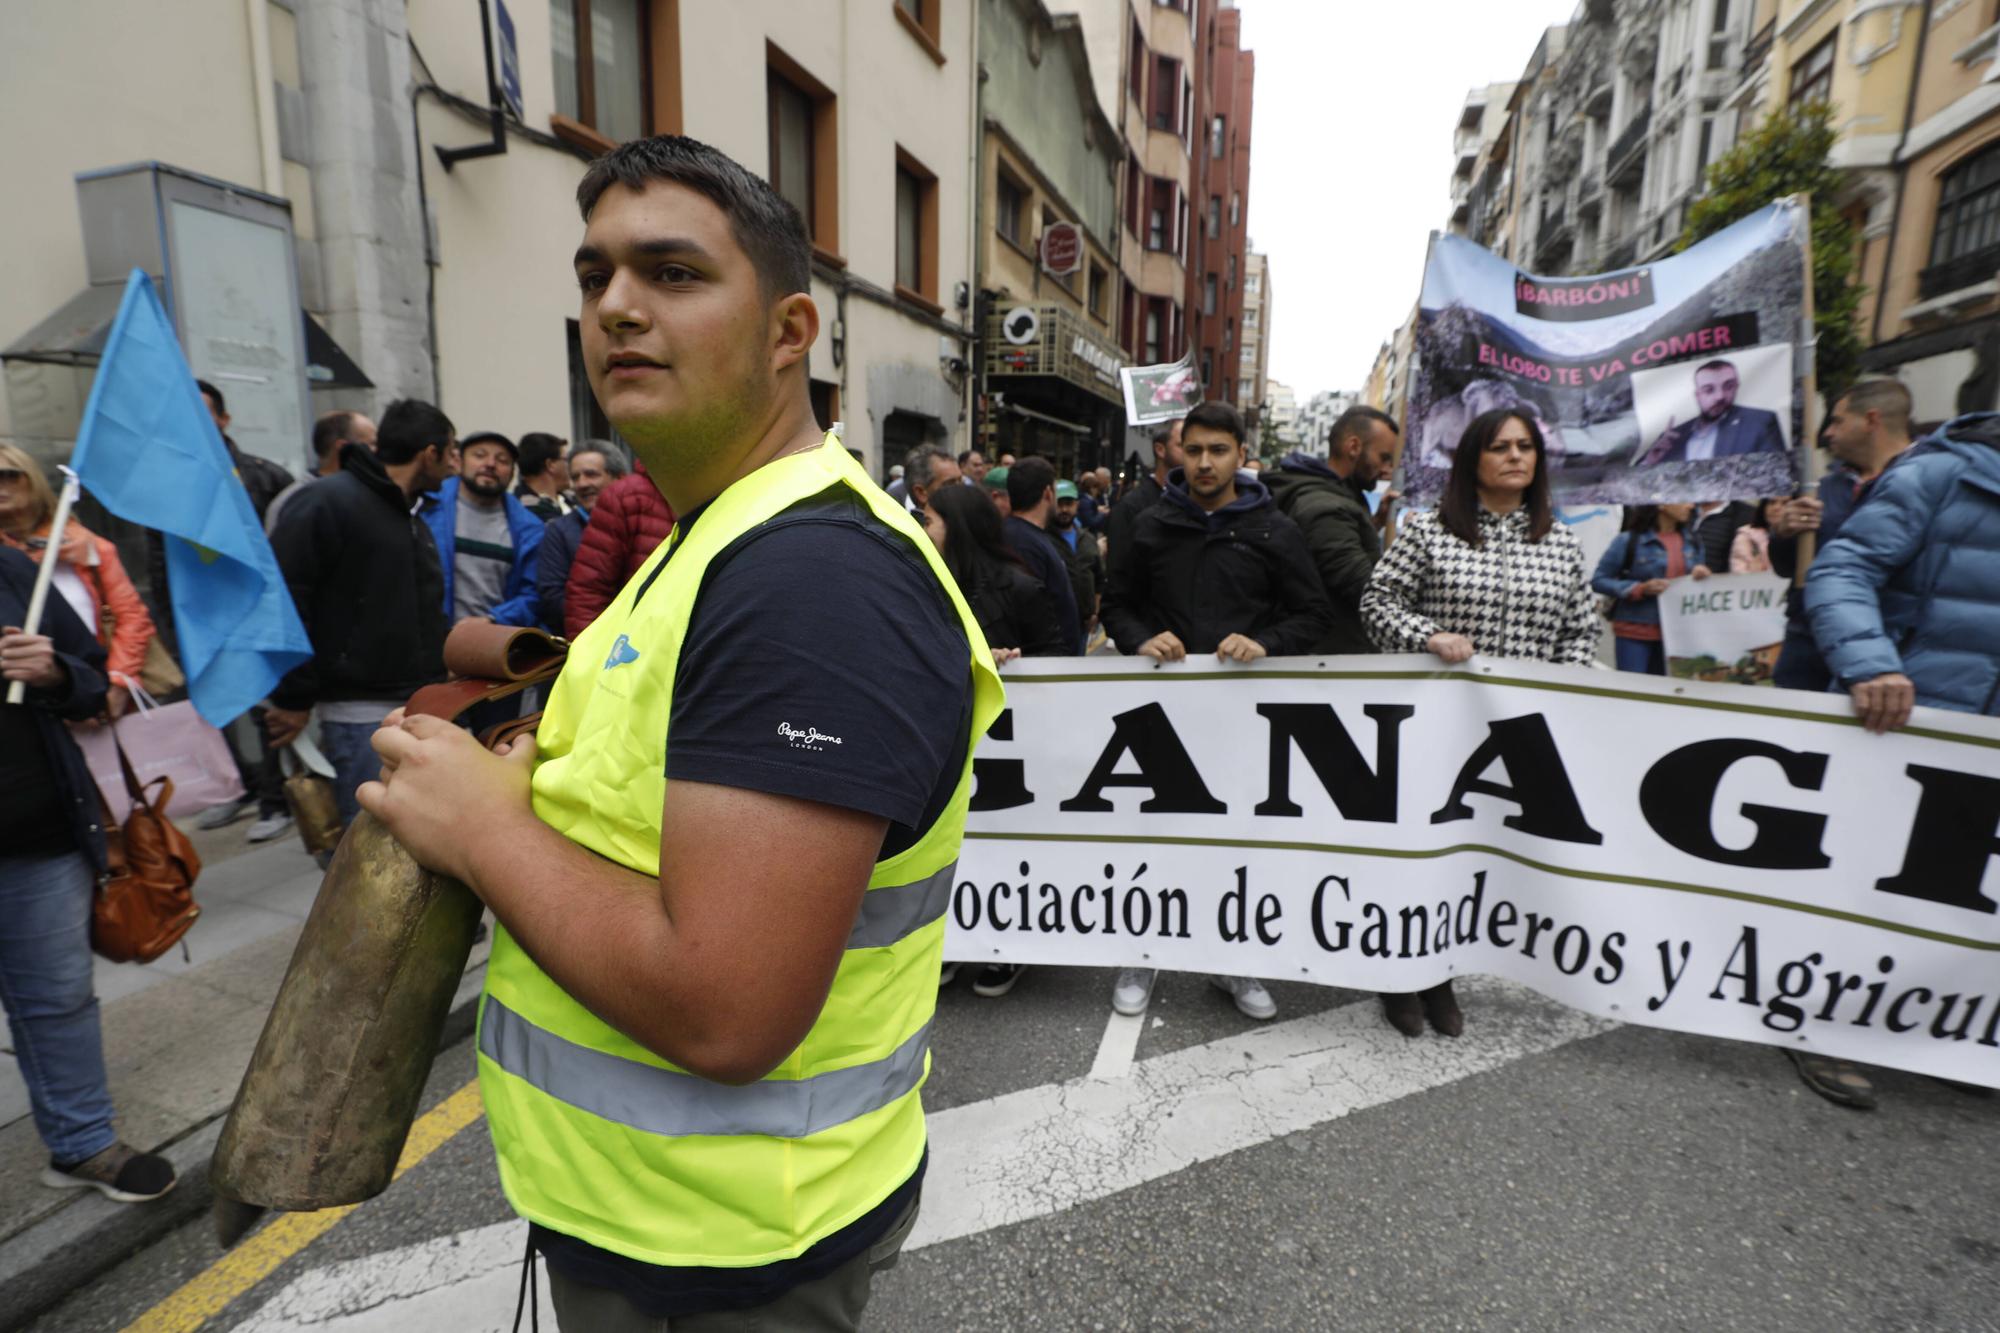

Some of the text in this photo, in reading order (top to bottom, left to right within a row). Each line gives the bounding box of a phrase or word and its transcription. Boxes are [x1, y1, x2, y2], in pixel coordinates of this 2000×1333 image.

[1516, 277, 1641, 307] ¡BARBÓN!
[1478, 324, 1732, 386] EL LOBO TE VA COMER
[1681, 589, 1733, 616] HACE
[1740, 588, 1773, 611] UN
[777, 721, 843, 745] Pepe Jeans
[953, 861, 1191, 938] ociación
[1217, 866, 1283, 946] de
[1311, 870, 1627, 985] Ganaderos
[1647, 940, 1692, 1012] y
